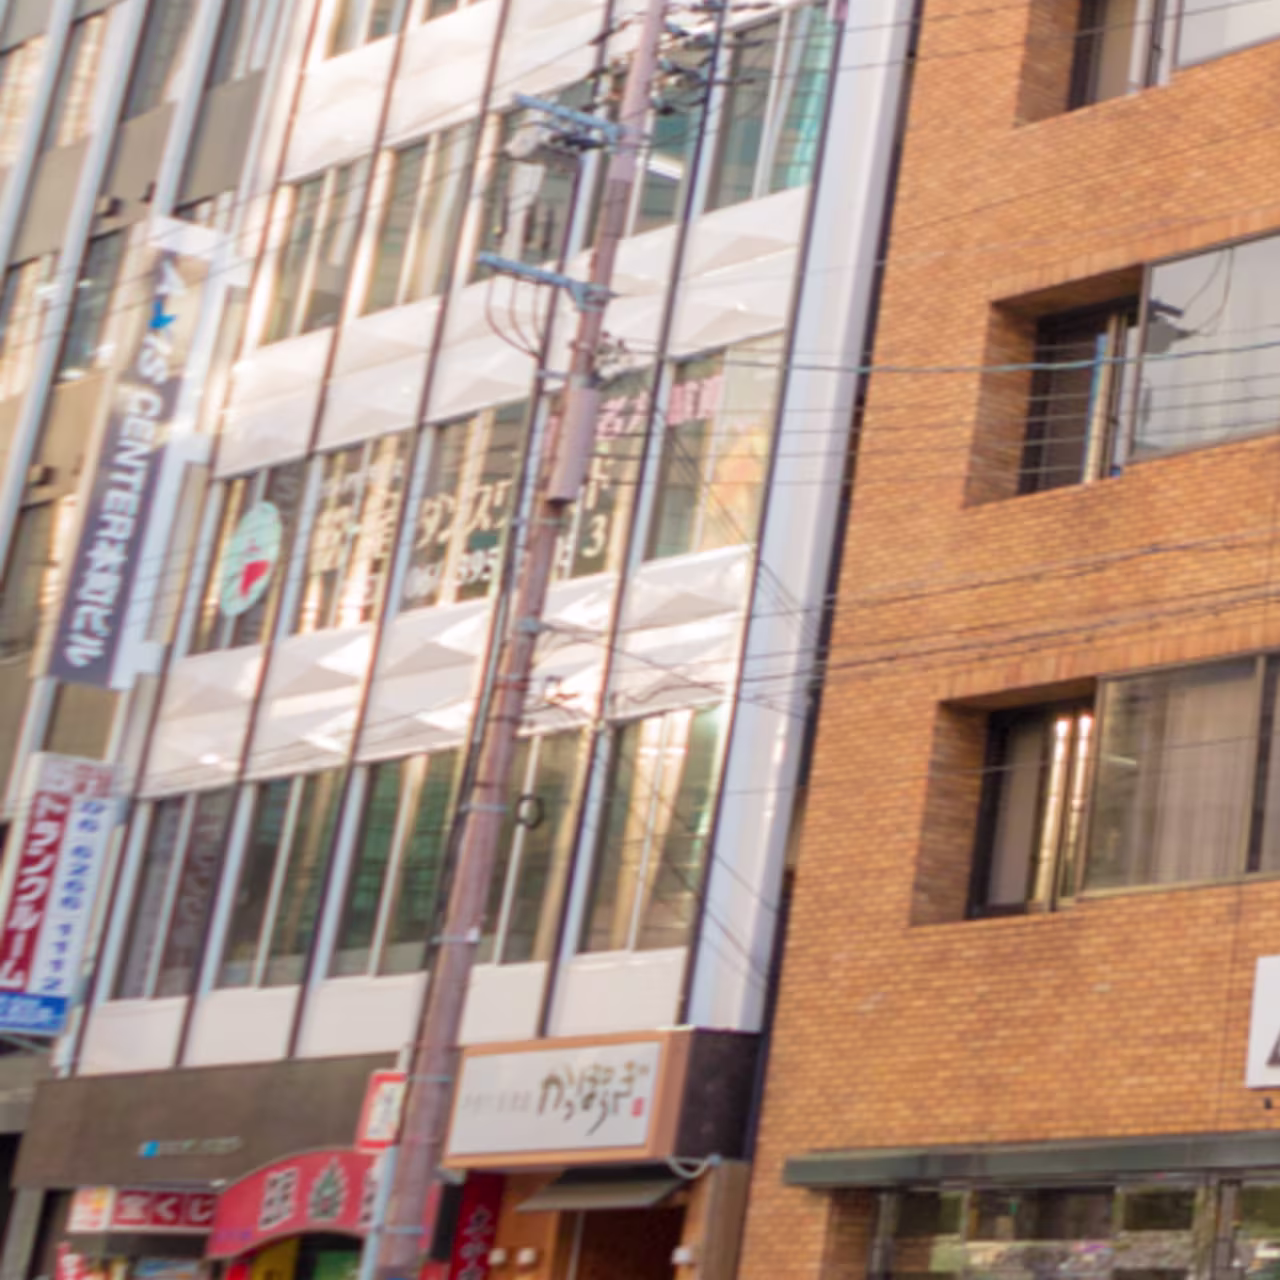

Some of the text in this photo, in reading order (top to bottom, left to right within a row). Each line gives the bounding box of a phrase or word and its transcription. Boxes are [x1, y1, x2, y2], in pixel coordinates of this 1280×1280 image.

[0, 794, 68, 989] トランクルーム
